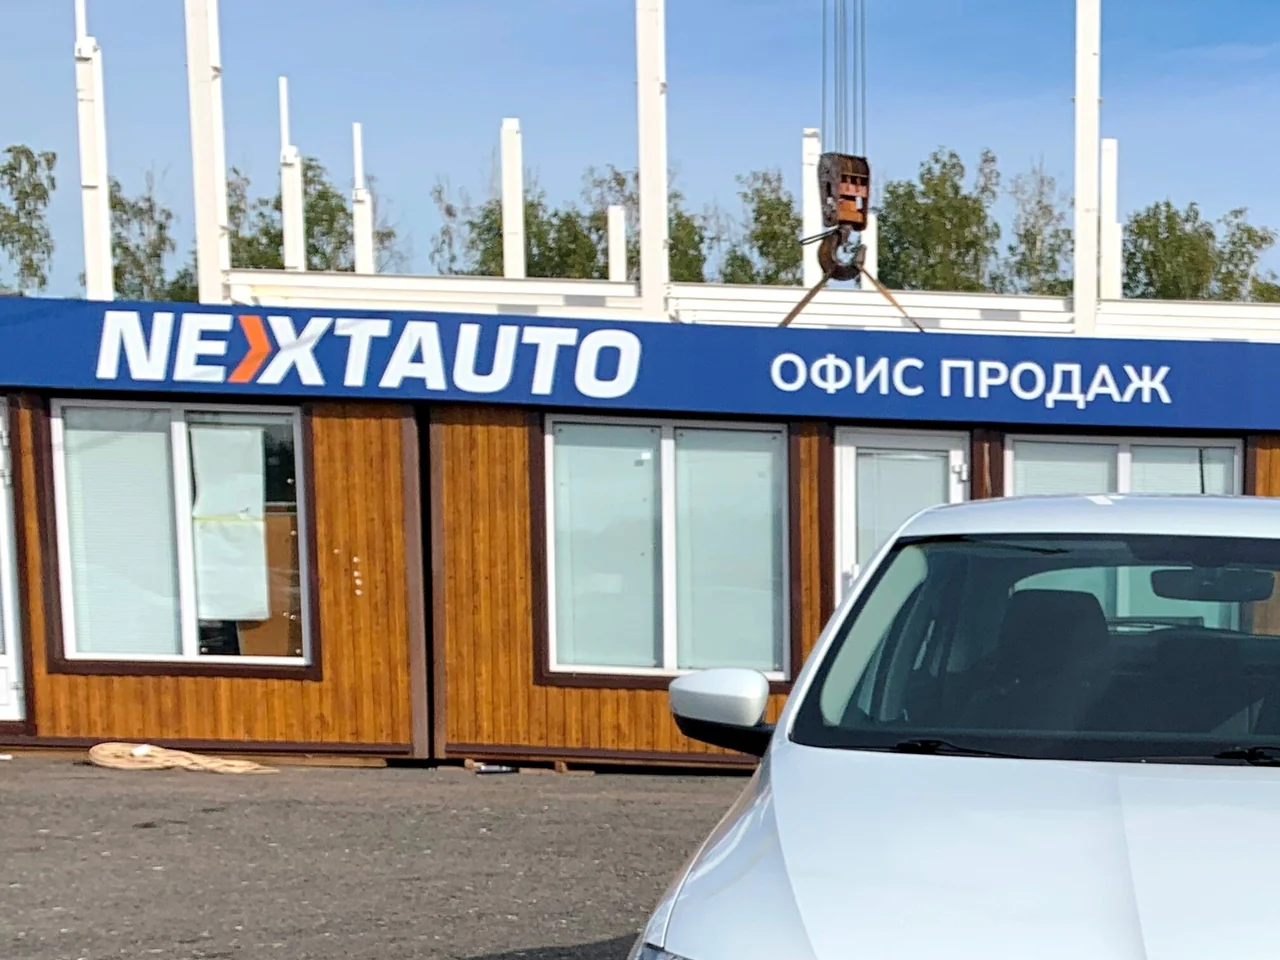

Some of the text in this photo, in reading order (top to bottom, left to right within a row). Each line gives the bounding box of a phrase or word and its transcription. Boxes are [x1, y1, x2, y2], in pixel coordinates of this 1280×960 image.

[96, 310, 642, 399] NEXTAUTO
[770, 352, 1171, 409] ОФИС ПРОДАЖ
